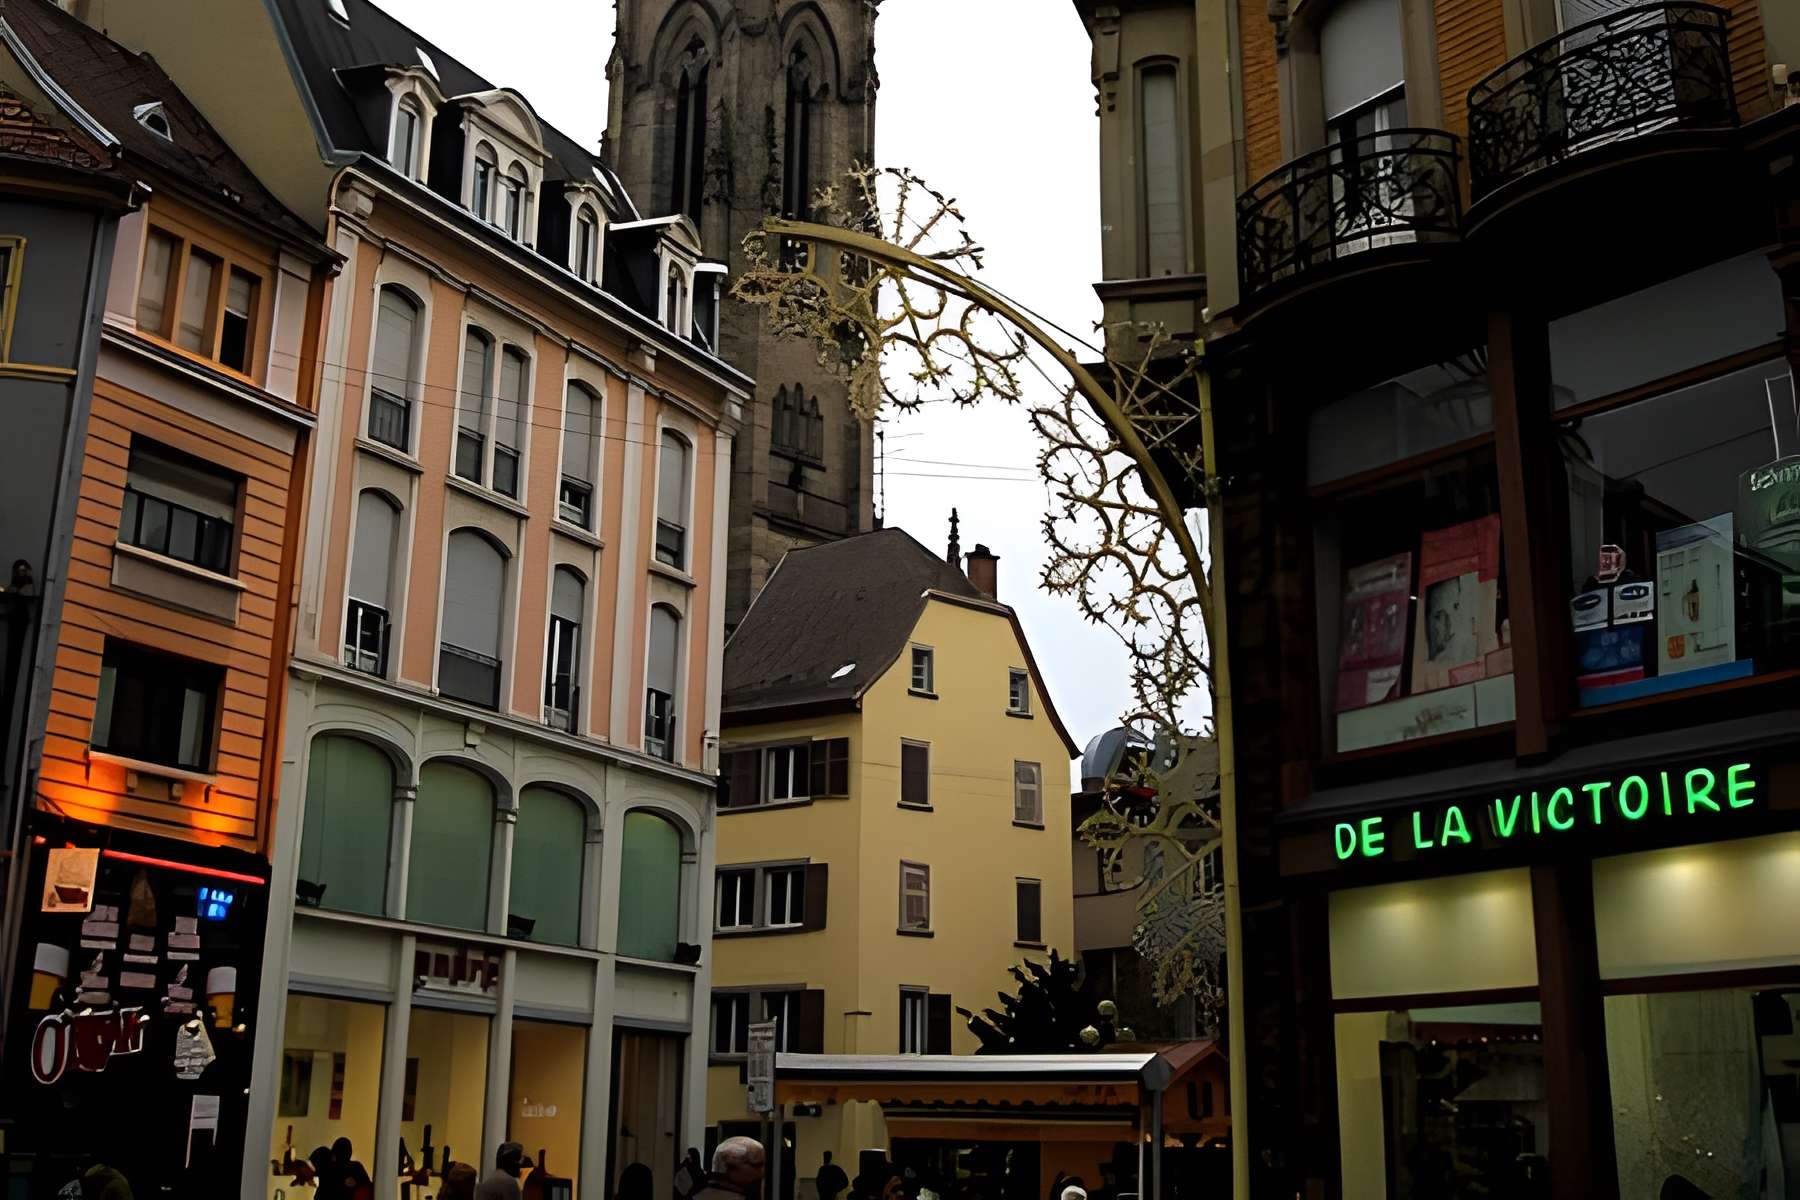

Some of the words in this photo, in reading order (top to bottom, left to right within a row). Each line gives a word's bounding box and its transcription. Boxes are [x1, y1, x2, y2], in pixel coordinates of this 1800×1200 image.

[1334, 817, 1386, 860] DE
[1412, 806, 1472, 849] LA
[1493, 762, 1757, 838] VICTOIRE
